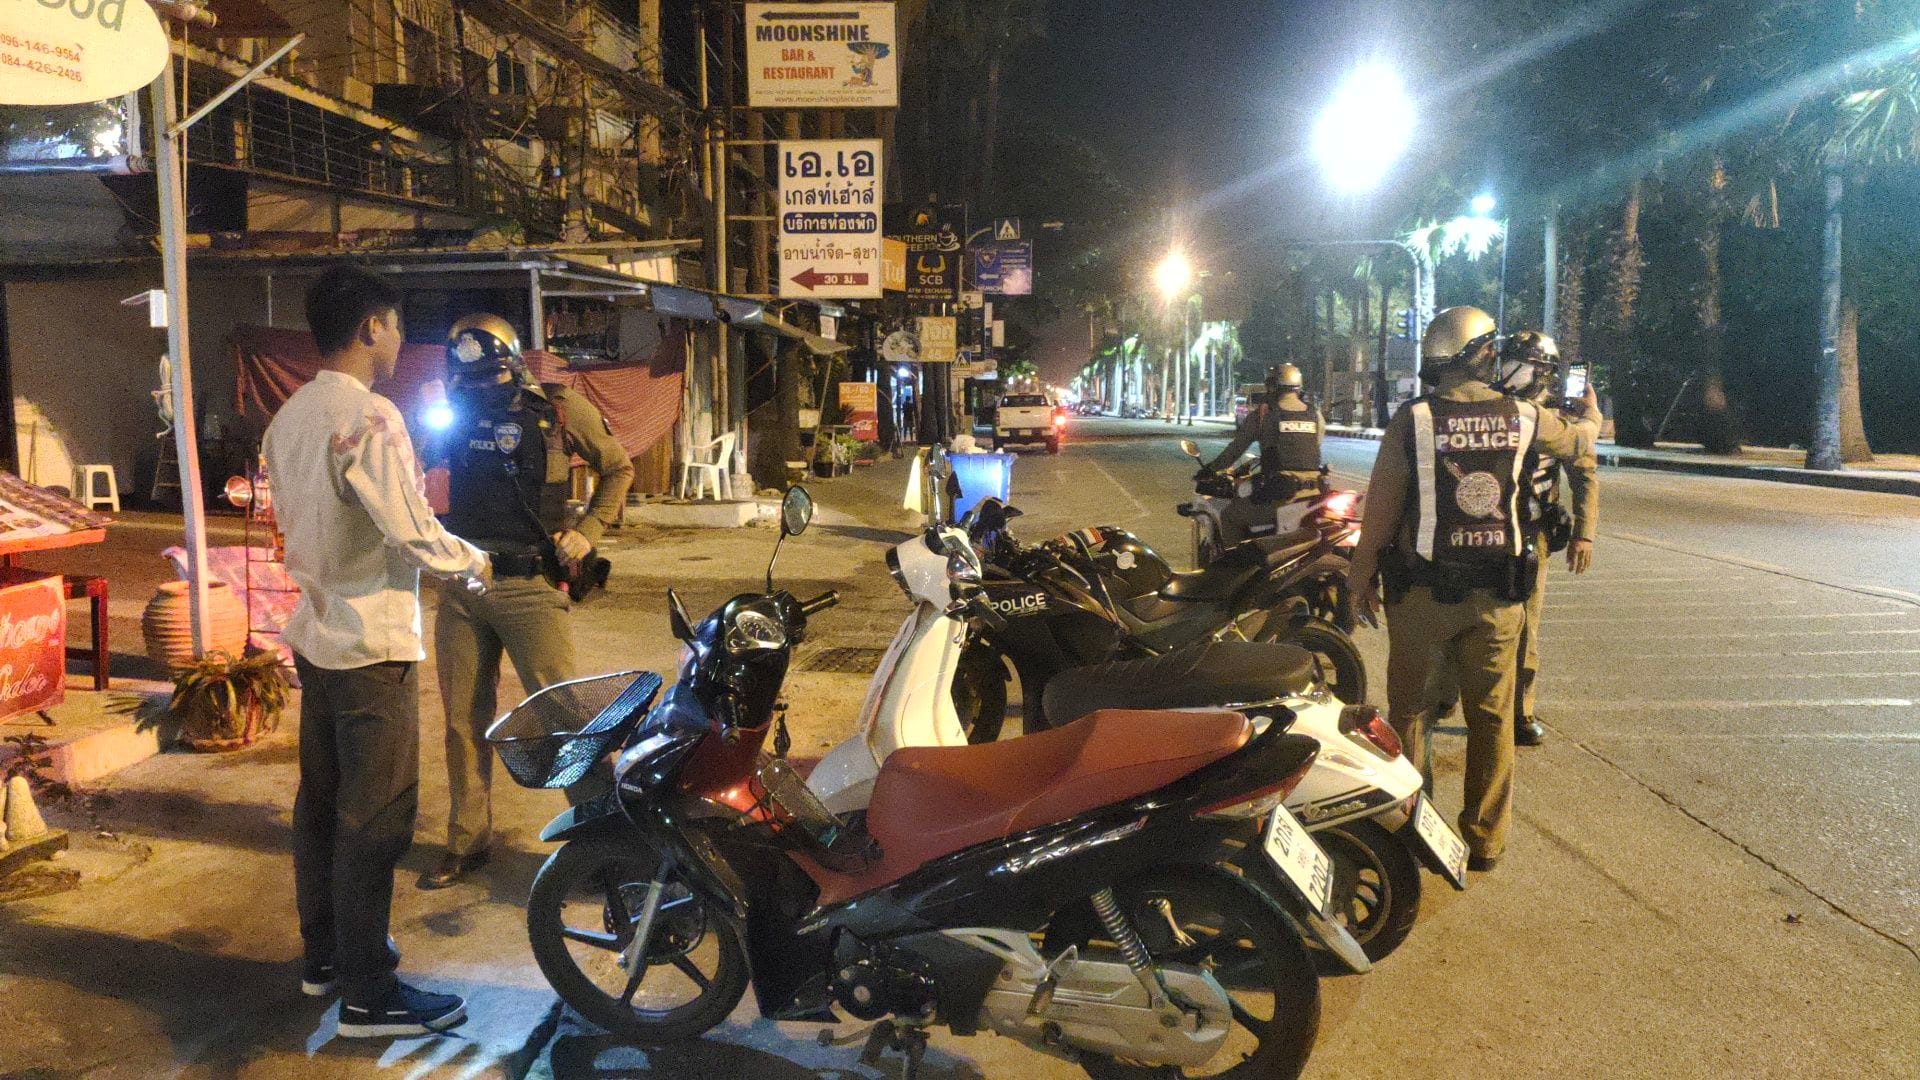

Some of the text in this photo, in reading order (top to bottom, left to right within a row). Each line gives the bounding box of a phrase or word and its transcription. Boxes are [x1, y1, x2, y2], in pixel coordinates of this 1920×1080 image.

[756, 24, 870, 42] MOONSHINE
[781, 48, 816, 62] BAR &
[763, 66, 836, 80] RESTAURANT
[785, 150, 874, 178] เอ.เอ
[823, 275, 838, 285] 30
[919, 275, 944, 285] SCB
[1448, 416, 1508, 433] PATTAYA
[1435, 432, 1520, 450] POLICE
[1450, 527, 1506, 546] ตำรวจ
[990, 593, 1046, 613] POLICE
